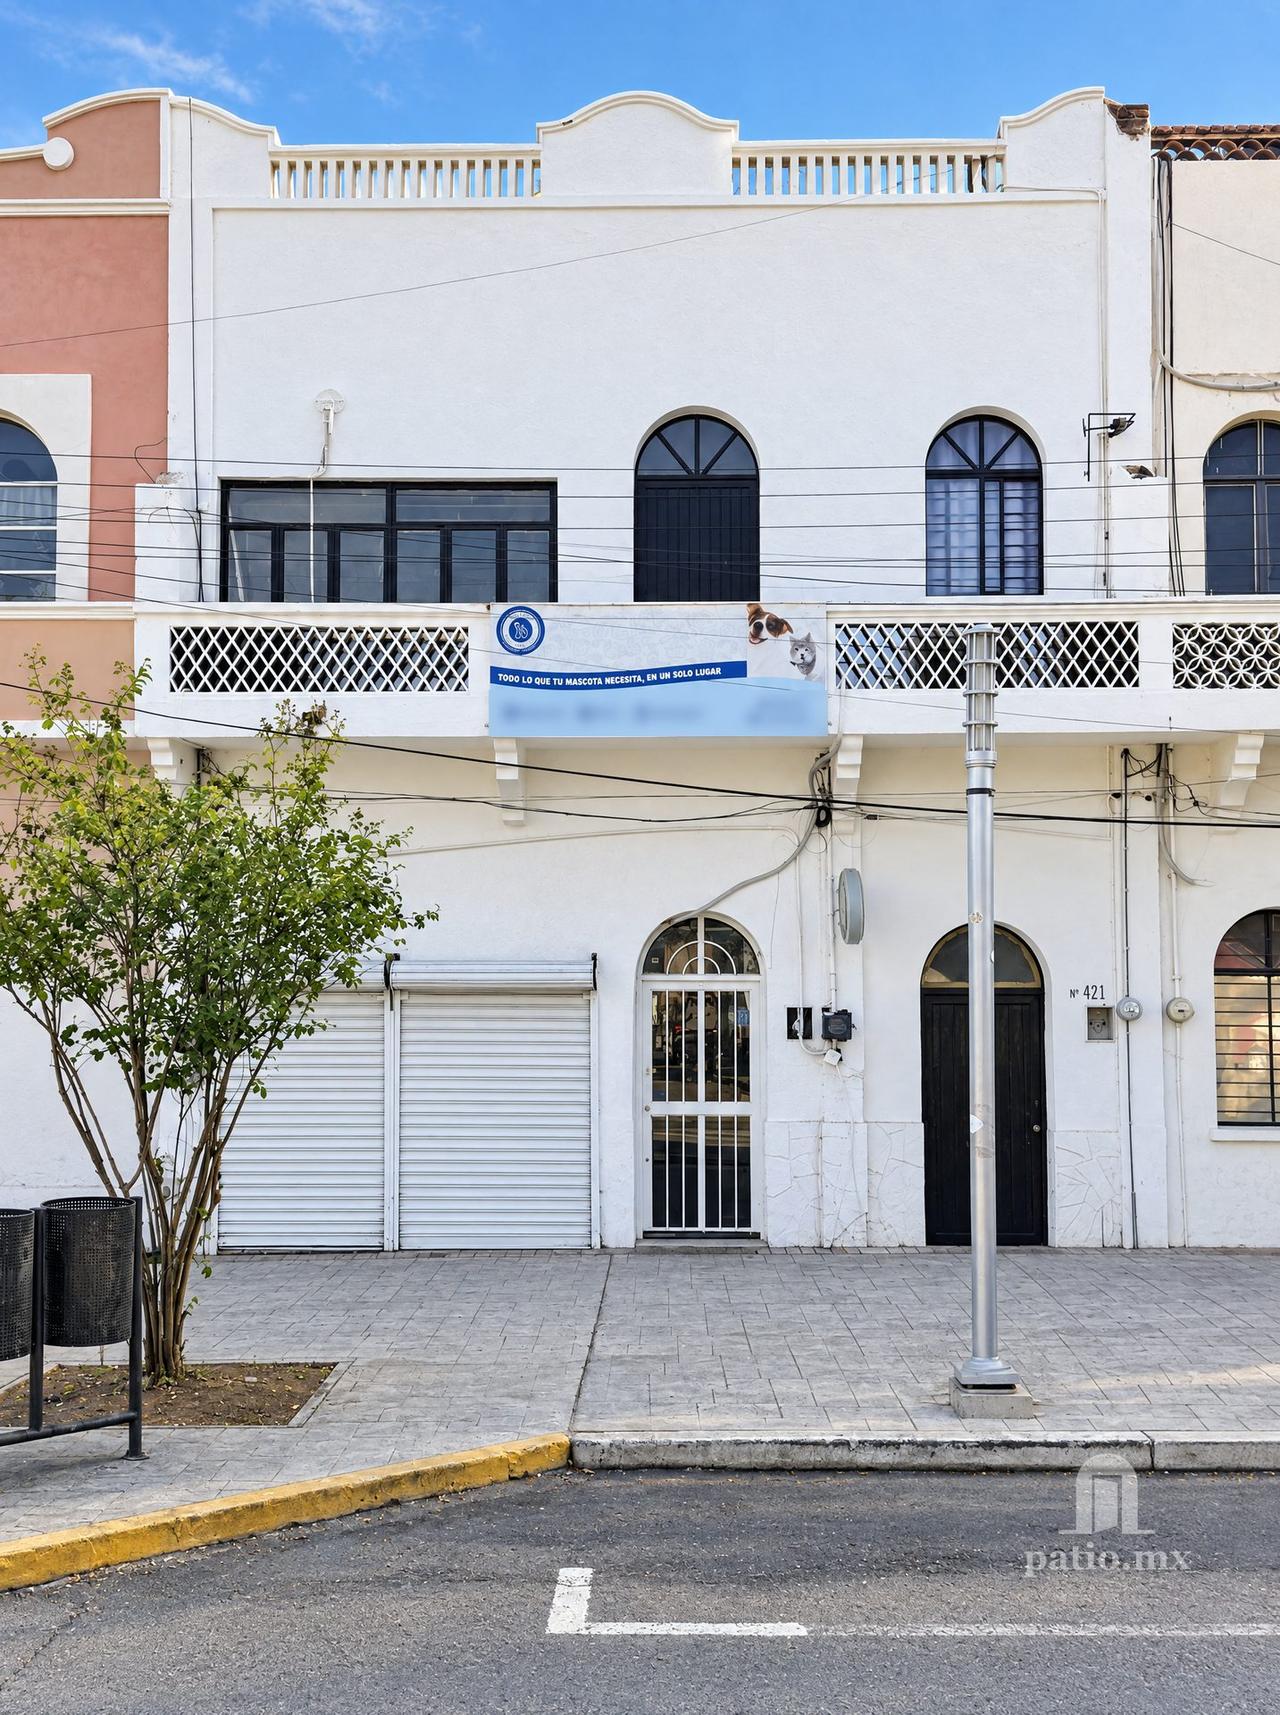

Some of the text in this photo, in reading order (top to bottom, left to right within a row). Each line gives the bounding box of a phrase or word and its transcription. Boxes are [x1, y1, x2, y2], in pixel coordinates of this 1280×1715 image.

[498, 667, 722, 686] TODO LO QUE TU MASCOTA NECESITA, EN UN SOLO LUGAR
[1083, 985, 1105, 1000] 421
